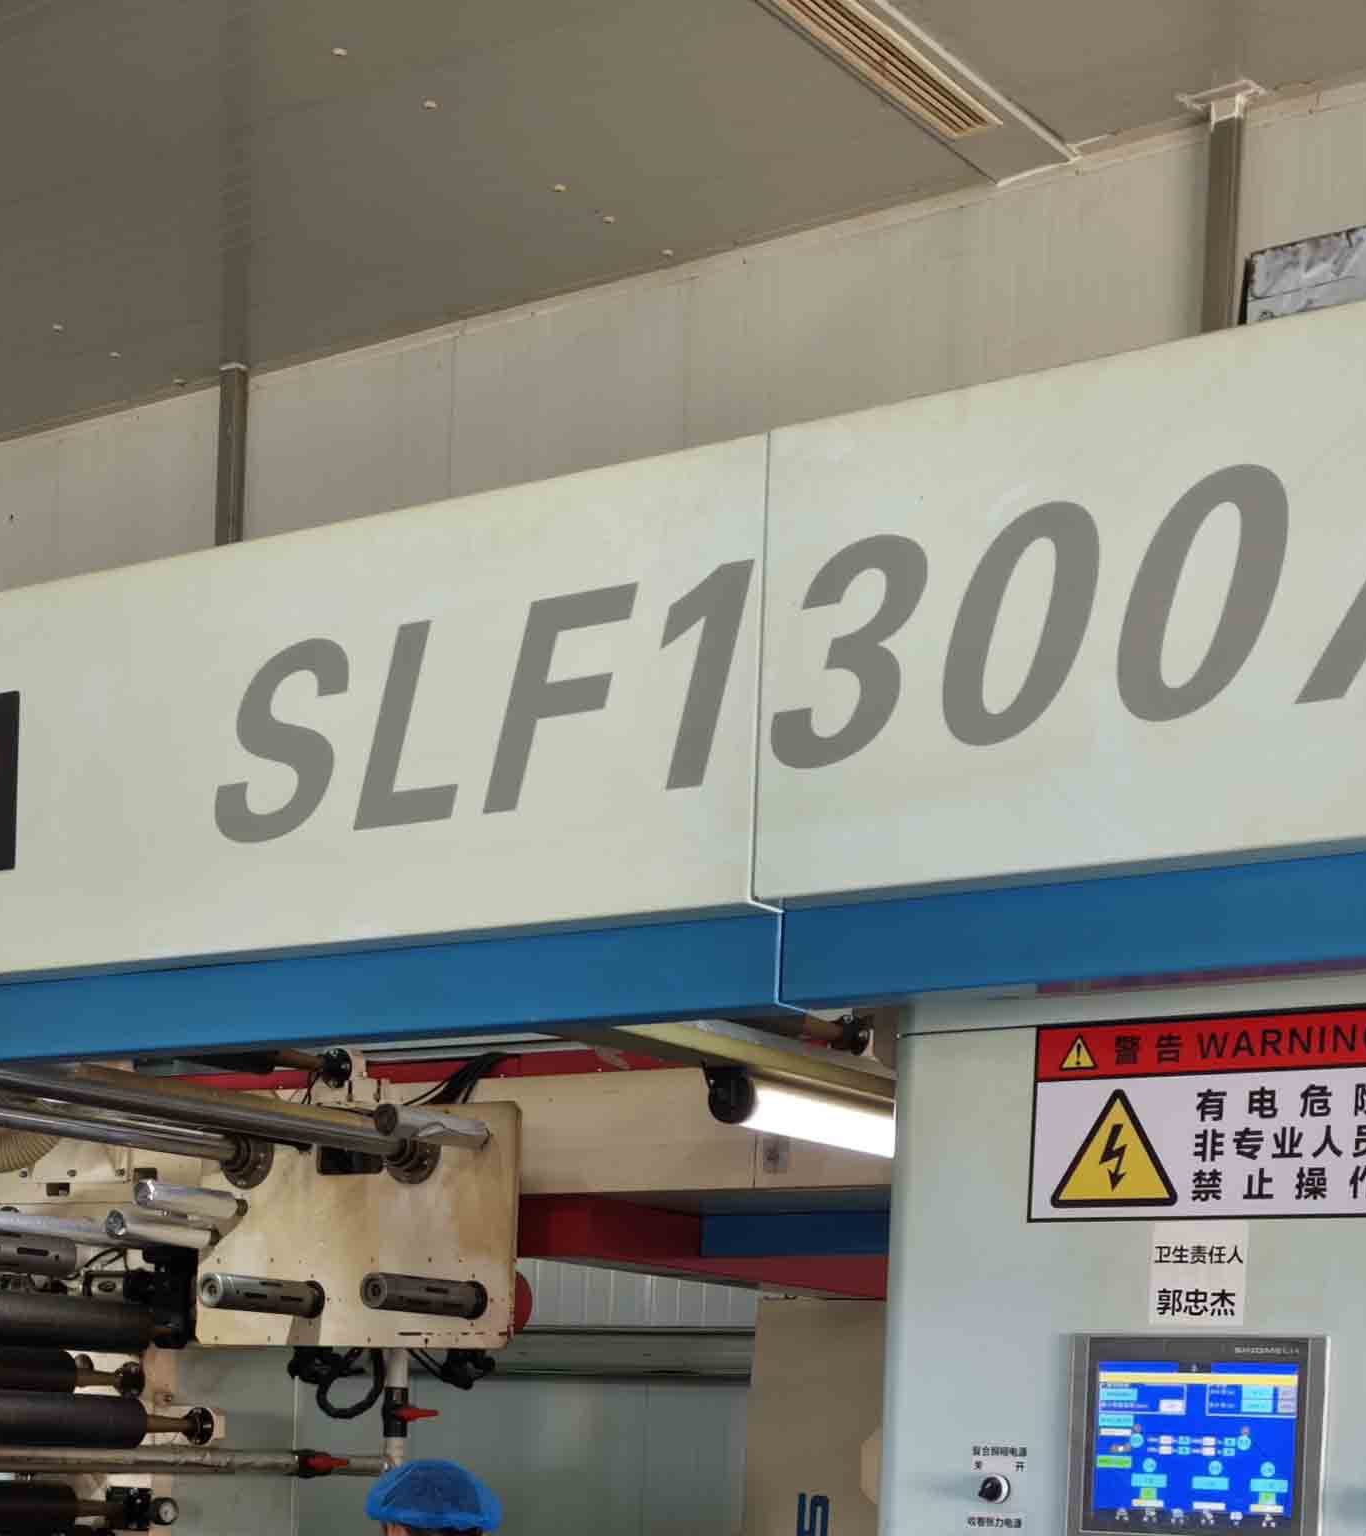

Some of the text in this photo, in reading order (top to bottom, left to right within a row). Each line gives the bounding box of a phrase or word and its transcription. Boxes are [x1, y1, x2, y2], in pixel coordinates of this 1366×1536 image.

[1114, 1033, 1183, 1066] 警告
[1154, 1243, 1244, 1267] 卫生责任人
[1156, 1288, 1236, 1316] 郭忠杰
